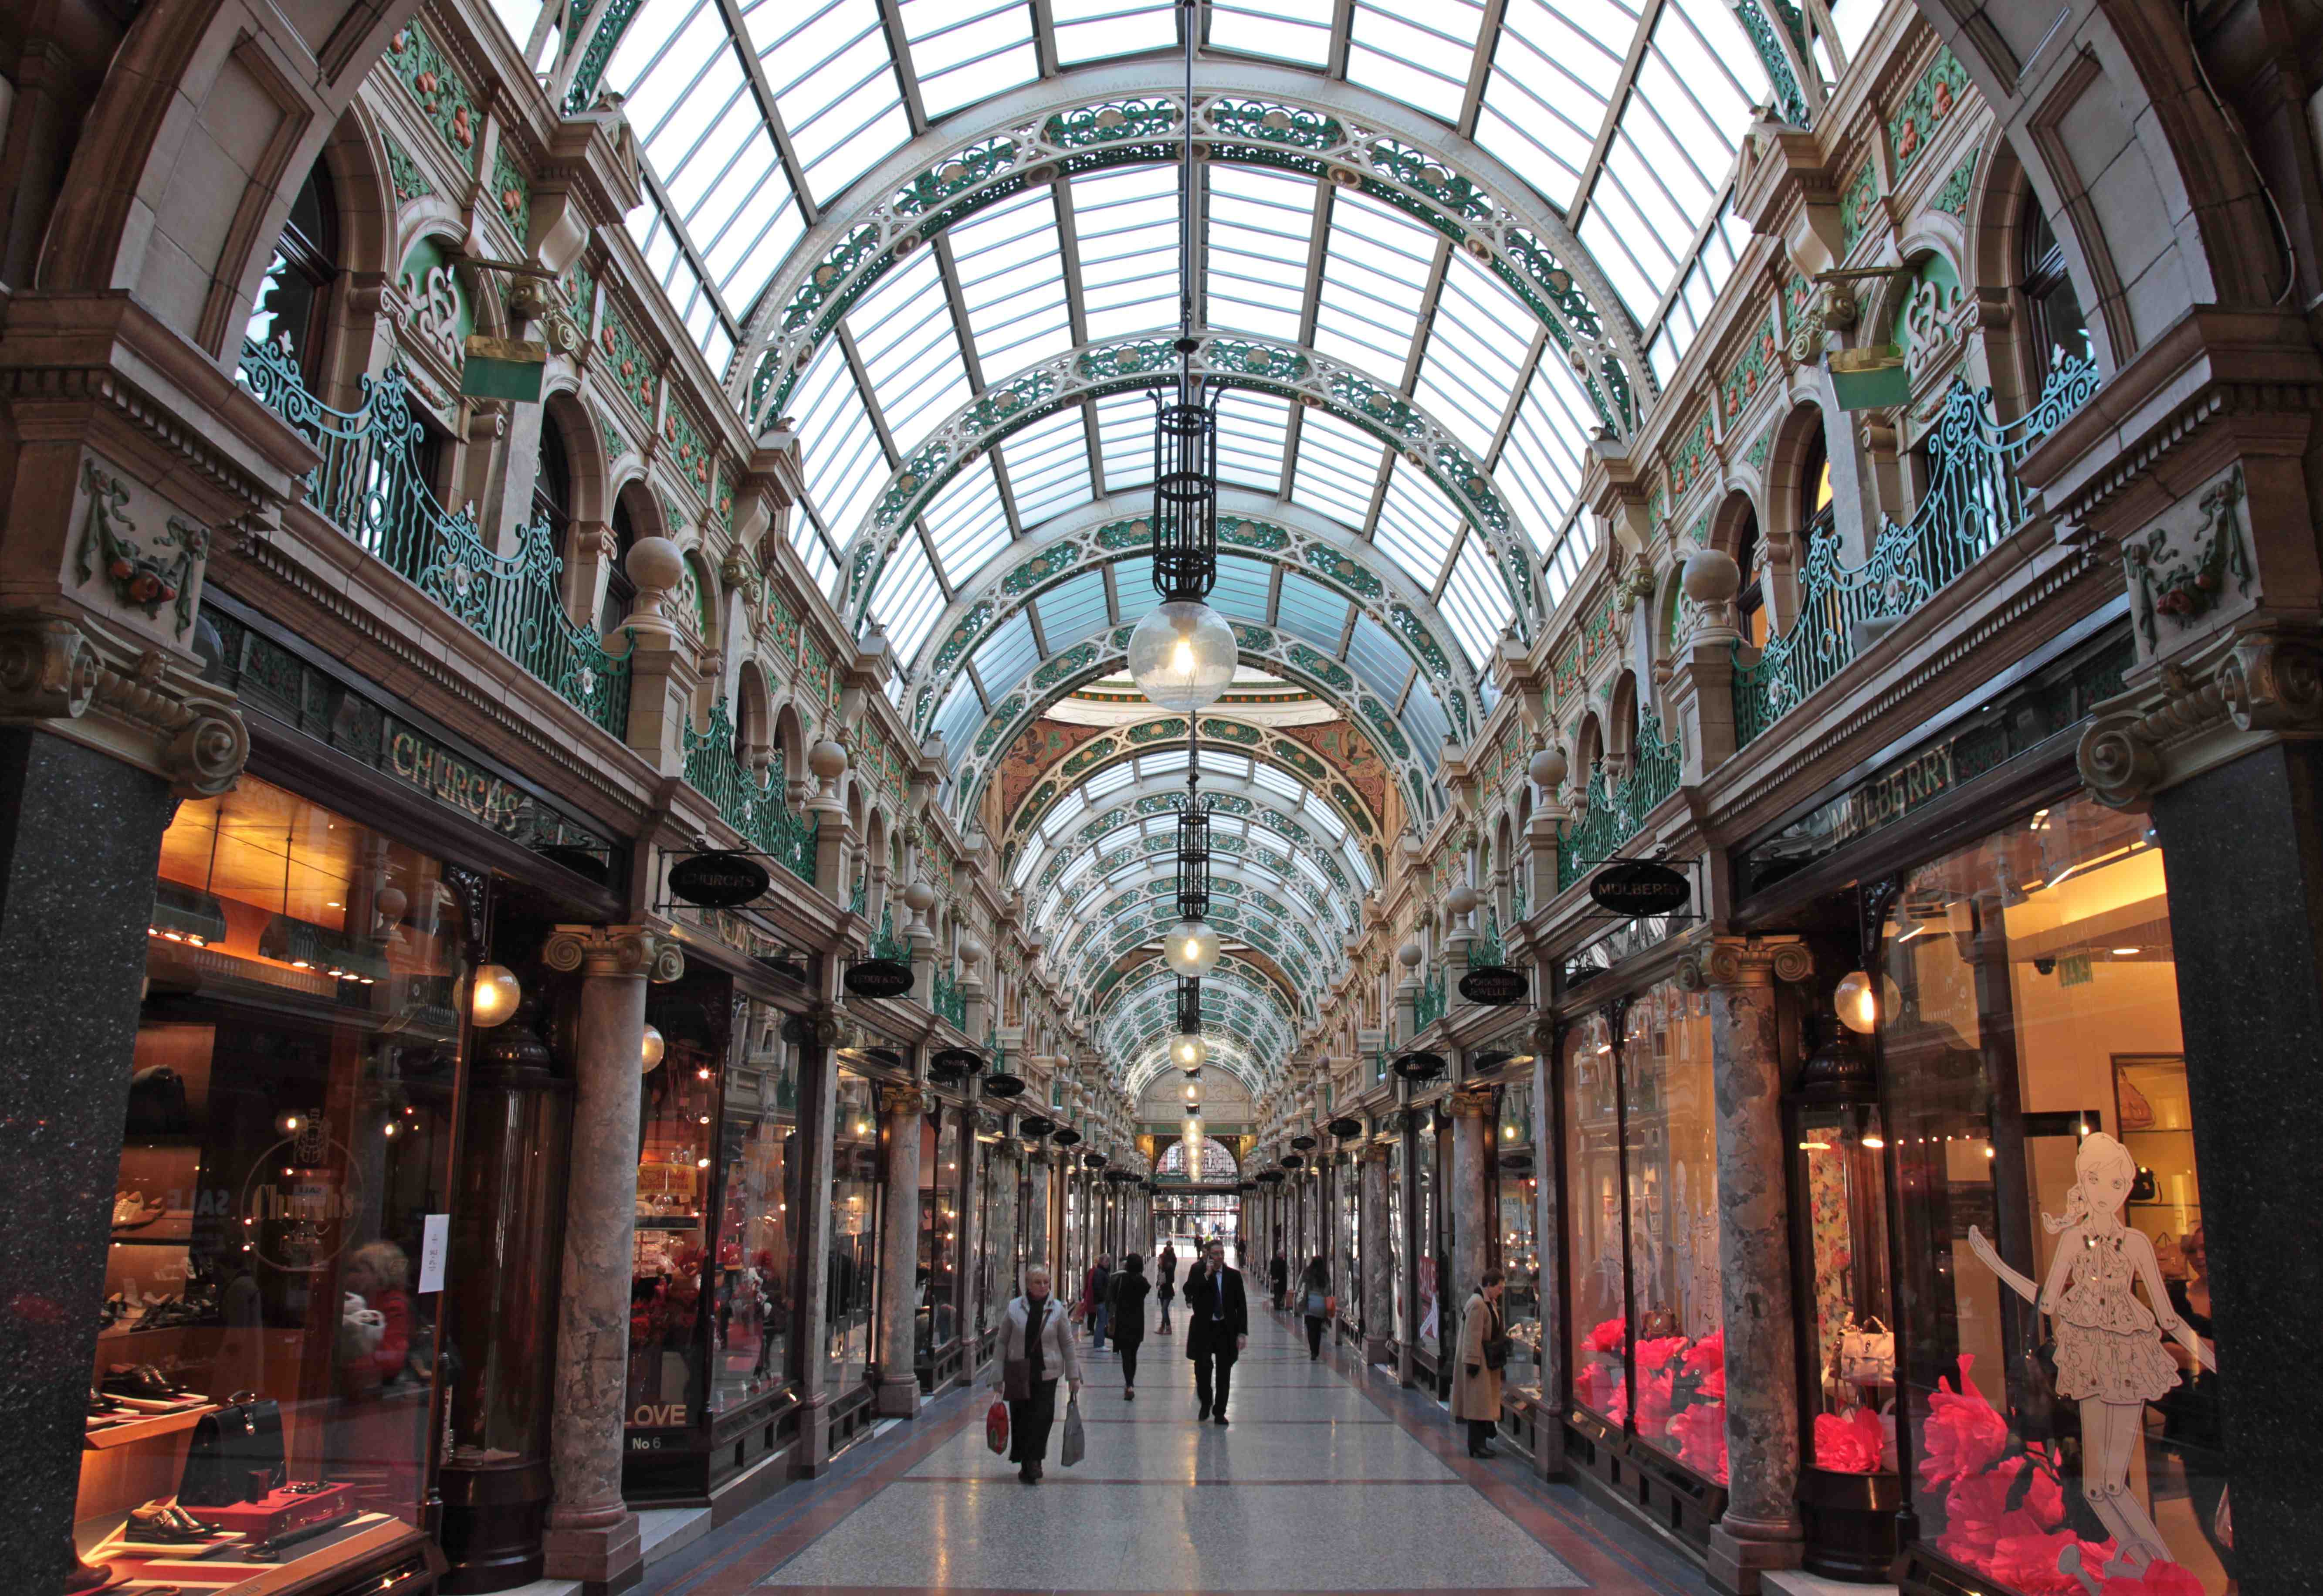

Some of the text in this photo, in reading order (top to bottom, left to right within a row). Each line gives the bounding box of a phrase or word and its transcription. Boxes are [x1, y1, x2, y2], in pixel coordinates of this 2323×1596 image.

[1831, 736, 1957, 844] MULBERRY
[1599, 883, 1680, 895] MULBERRY
[623, 1404, 687, 1426] OVE
[633, 1437, 661, 1450] No 6
